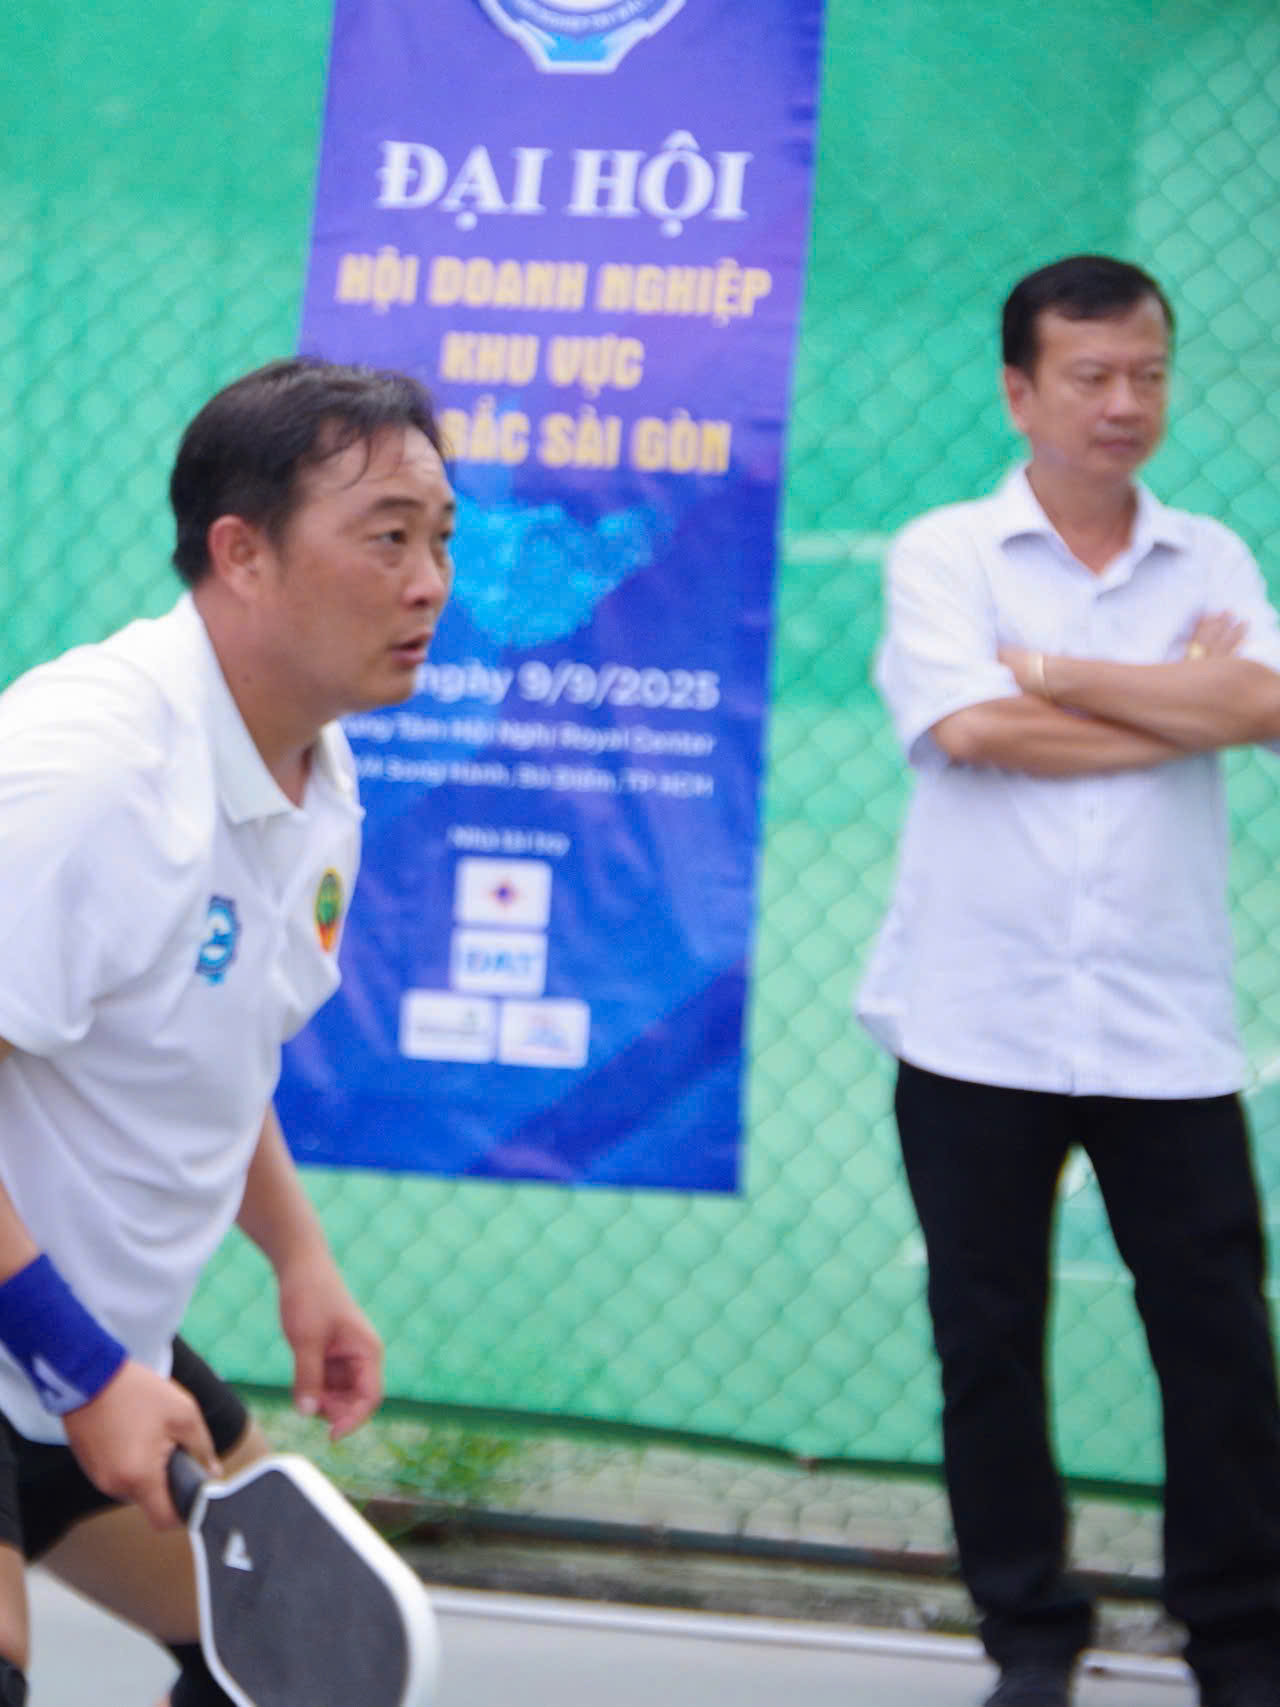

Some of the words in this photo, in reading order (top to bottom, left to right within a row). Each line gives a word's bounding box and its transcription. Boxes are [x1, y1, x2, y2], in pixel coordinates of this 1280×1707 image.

[375, 139, 552, 232] ĐẠI
[567, 129, 754, 238] HỘI
[335, 245, 421, 314] HỘI
[426, 255, 588, 311] DOANH
[596, 257, 773, 328] NGHIỆP
[438, 331, 539, 387] KHU
[546, 332, 645, 398] VỰC
[537, 403, 622, 469] SÀI
[632, 407, 732, 476] GÒN
[518, 659, 720, 711] 9/9/2025
